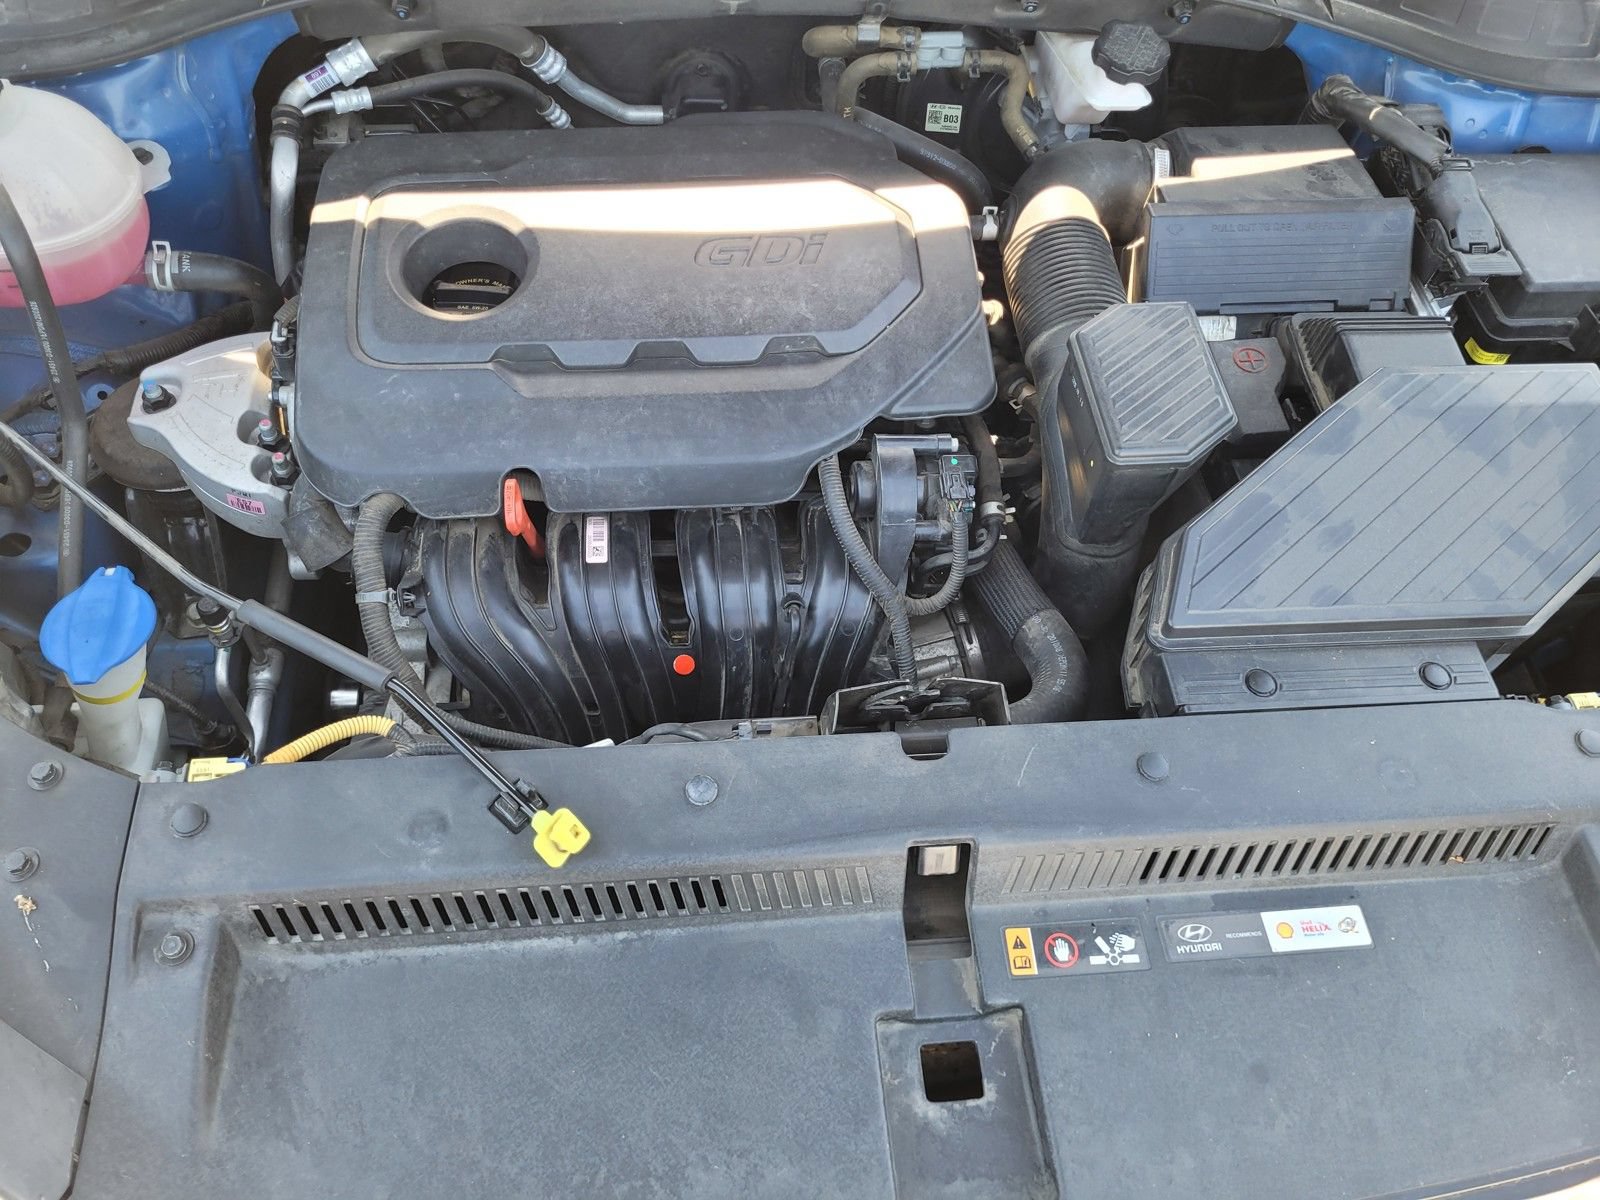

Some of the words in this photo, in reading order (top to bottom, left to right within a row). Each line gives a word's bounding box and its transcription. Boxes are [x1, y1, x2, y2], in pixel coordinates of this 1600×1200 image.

[943, 114, 959, 124] B03
[1301, 924, 1332, 934] HELIX
[1225, 930, 1263, 939] RECOMMENDS
[1176, 942, 1223, 954] HYUNDAI
